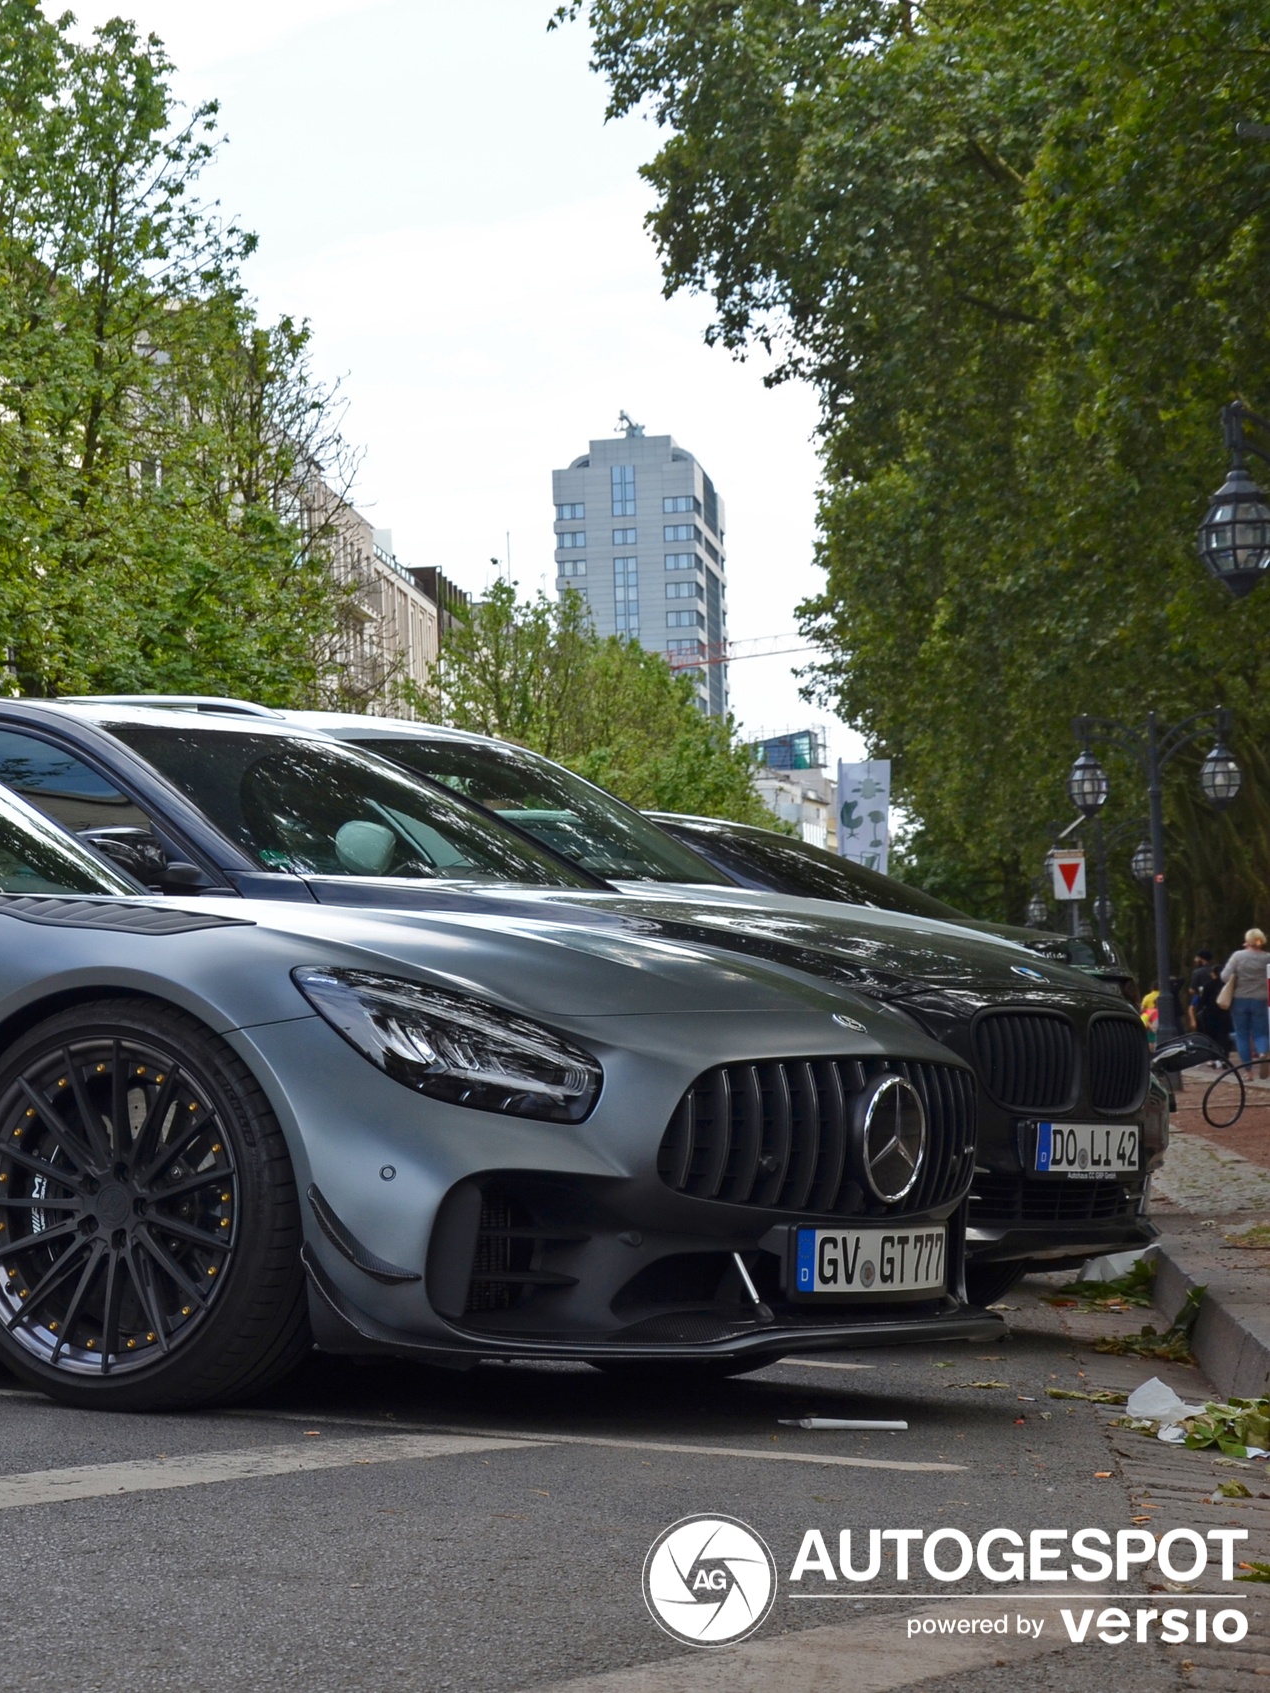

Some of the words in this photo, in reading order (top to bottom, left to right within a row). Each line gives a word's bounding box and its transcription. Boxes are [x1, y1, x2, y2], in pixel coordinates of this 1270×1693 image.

[216, 1072, 255, 1144] MICHELIN
[1041, 1152, 1047, 1162] D
[1051, 1129, 1077, 1166] DO
[1091, 1130, 1111, 1166] LI
[1116, 1131, 1136, 1167] 42
[801, 1268, 809, 1281] D
[818, 1236, 860, 1284] GV
[880, 1236, 909, 1283] GT
[914, 1233, 944, 1282] 777
